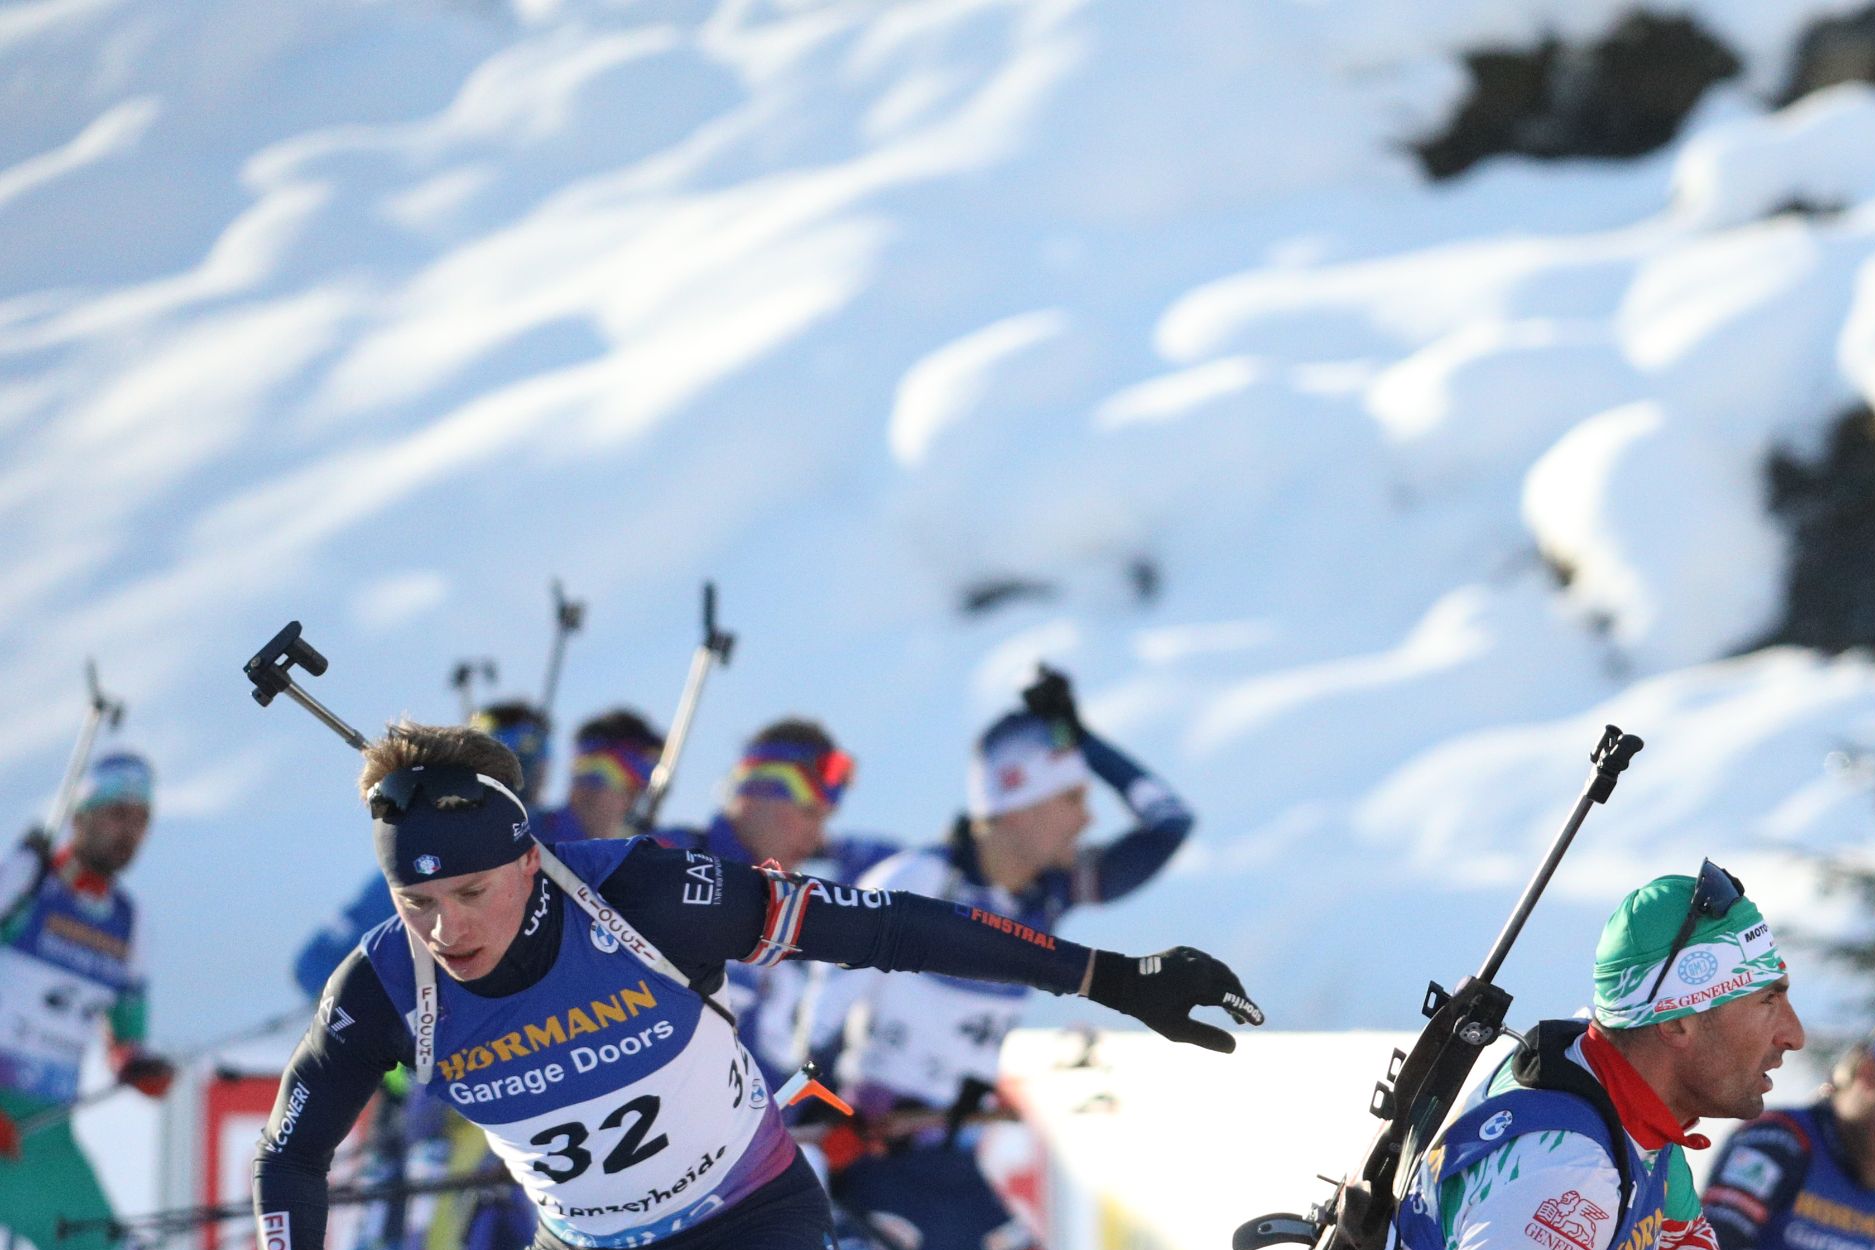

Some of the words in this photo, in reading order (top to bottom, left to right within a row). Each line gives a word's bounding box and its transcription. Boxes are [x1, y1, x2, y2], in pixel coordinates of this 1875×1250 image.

[577, 886, 658, 963] FIOCCHI
[970, 906, 1057, 952] FINSTRAL
[419, 986, 435, 1065] FIOCCHI
[1678, 971, 1754, 1008] GENERALI
[448, 1062, 565, 1105] Garage
[569, 1018, 675, 1075] Doors
[529, 1093, 670, 1185] 32
